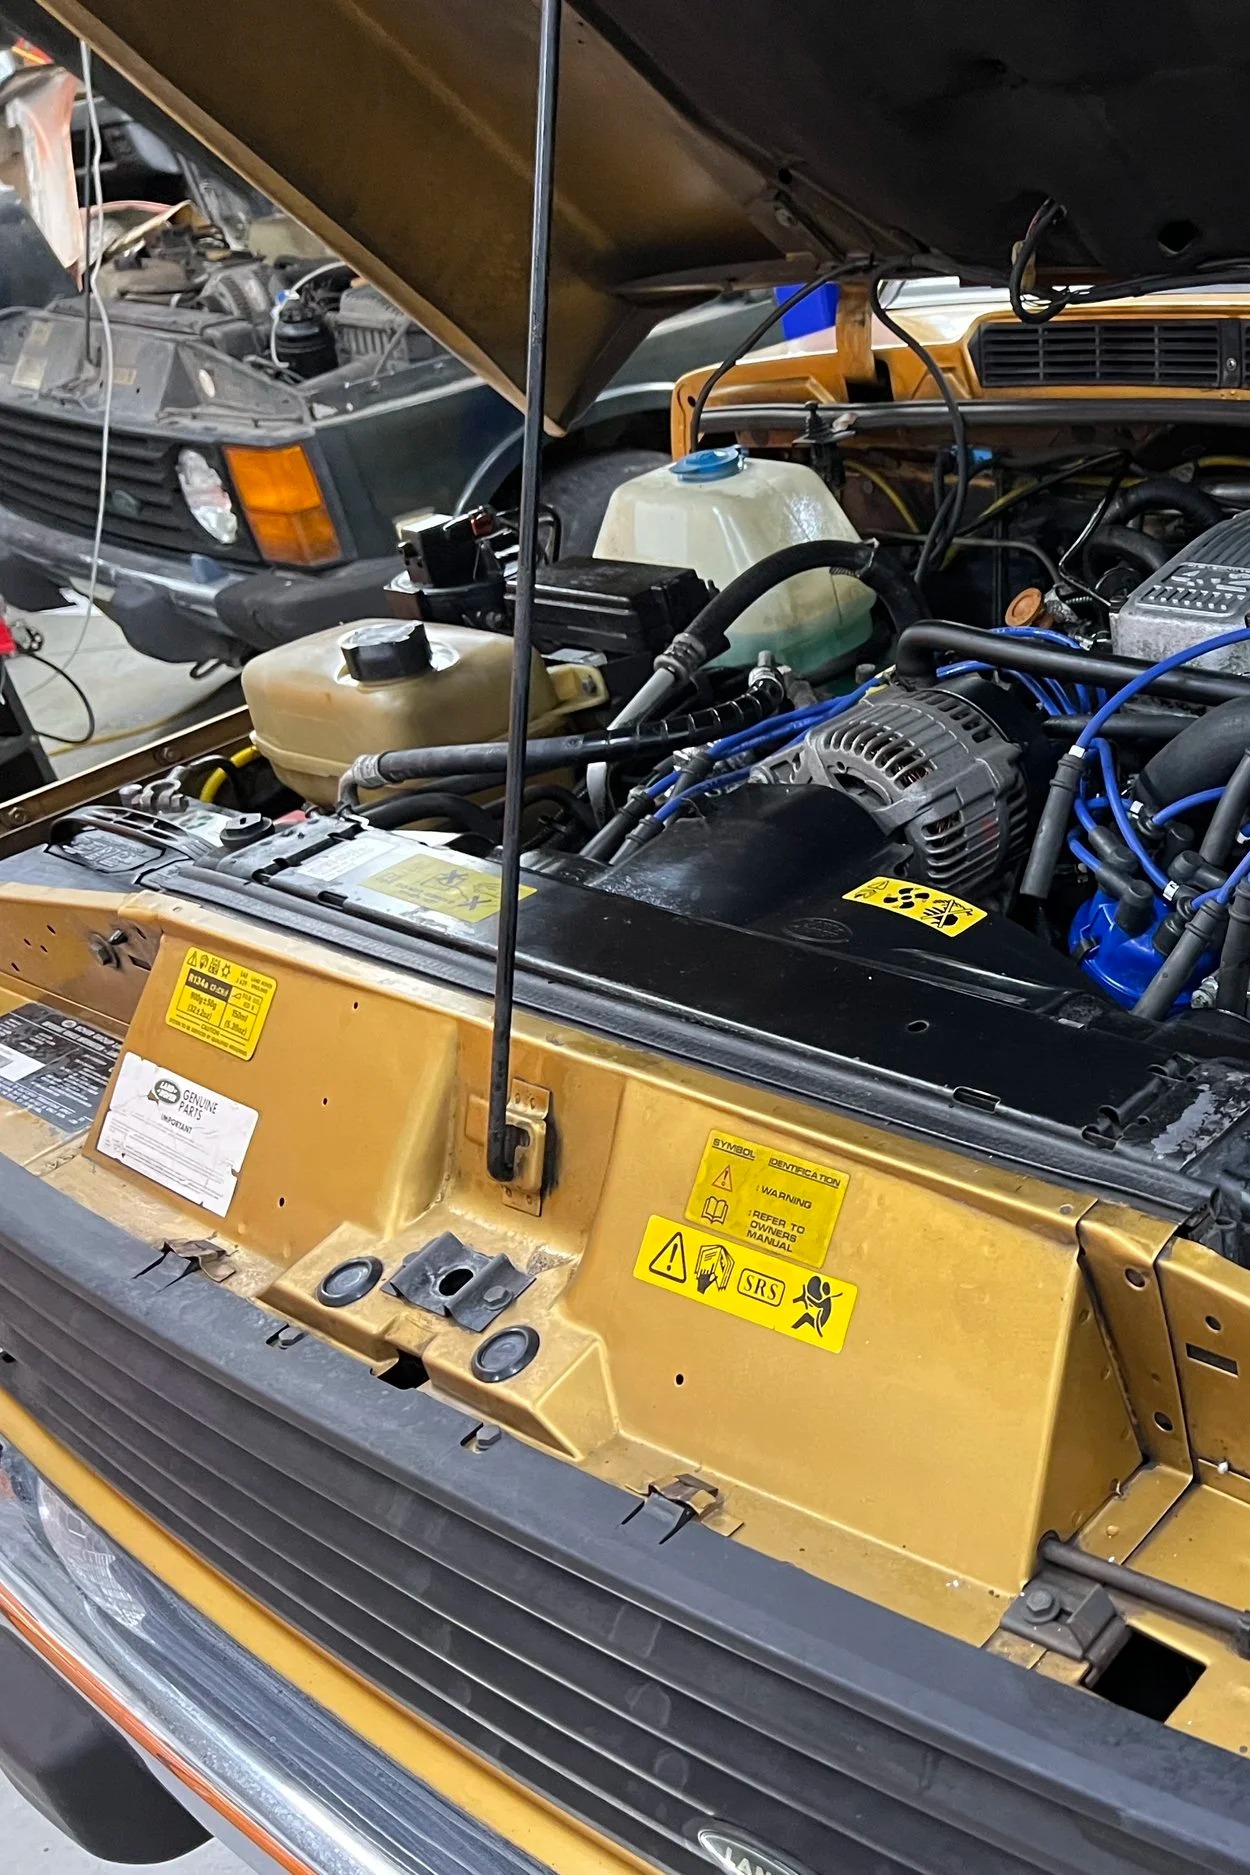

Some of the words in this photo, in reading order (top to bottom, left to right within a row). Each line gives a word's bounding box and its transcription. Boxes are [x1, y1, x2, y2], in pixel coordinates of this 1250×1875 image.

[178, 1101, 202, 1120] PARTS
[183, 1089, 219, 1114] GENUINE
[161, 1113, 192, 1134] IMPORTANT
[712, 1138, 756, 1160] SYMBOL
[768, 1157, 841, 1188] IDENTIFICATION
[750, 1220, 797, 1243] OWNERS
[790, 1222, 805, 1234] TO
[746, 1230, 793, 1253] MANUAL
[743, 1275, 778, 1301] SRS
